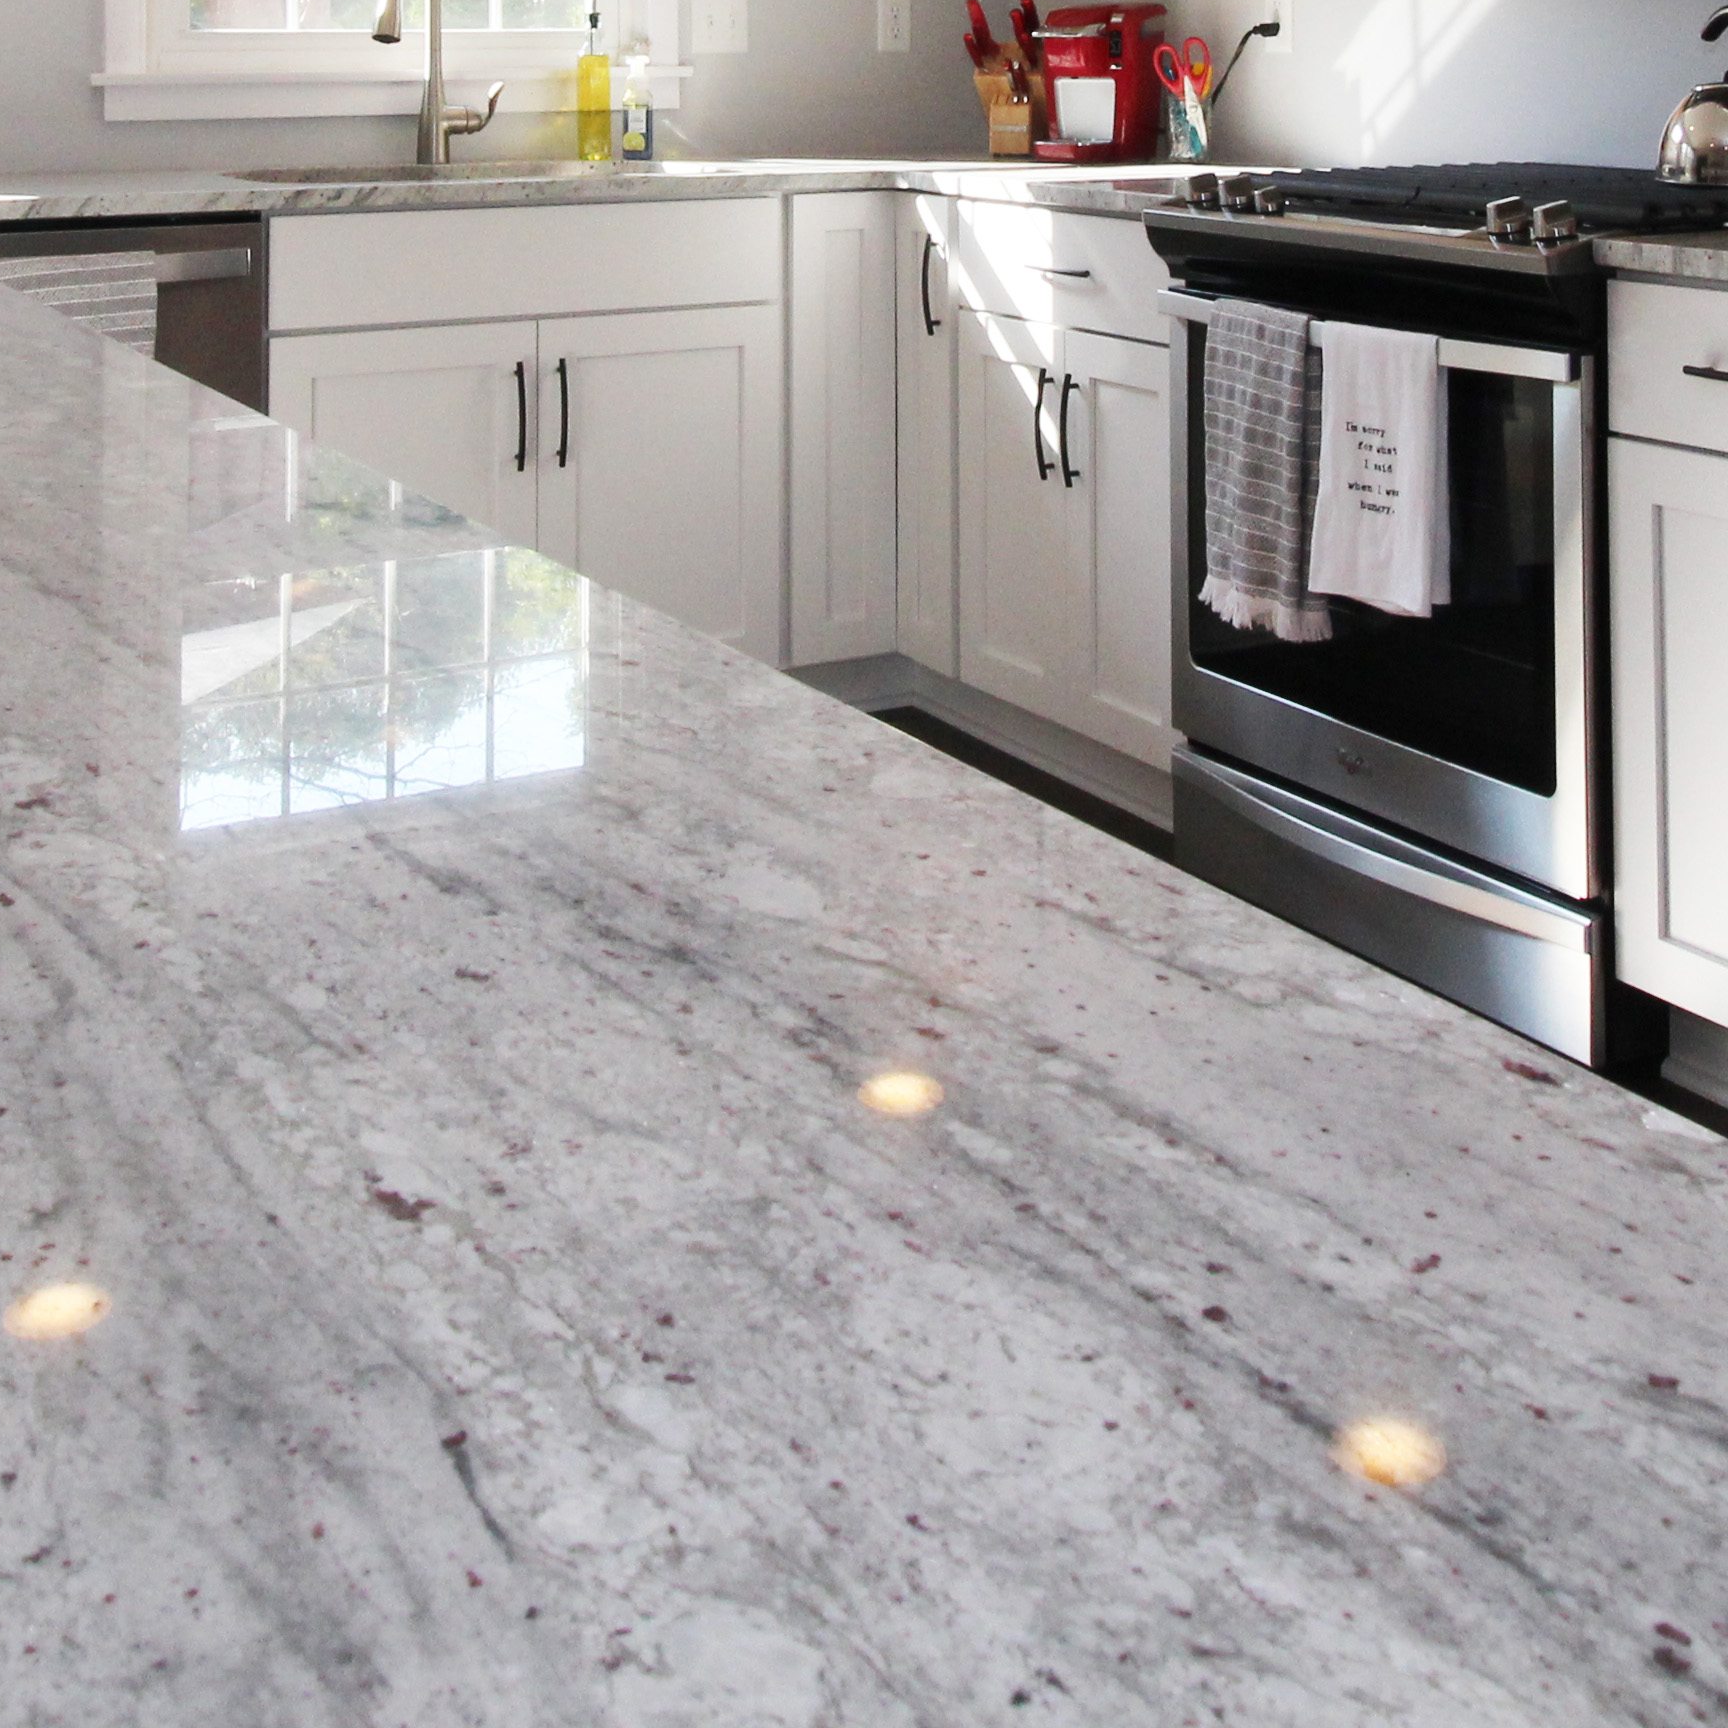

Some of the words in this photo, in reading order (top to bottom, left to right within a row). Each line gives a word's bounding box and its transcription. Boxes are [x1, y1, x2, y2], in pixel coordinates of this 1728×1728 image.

[1362, 426, 1385, 438] sorry
[1357, 440, 1373, 452] for
[1376, 446, 1398, 456] what
[1374, 462, 1393, 473] said
[1347, 481, 1373, 493] when
[1385, 488, 1400, 497] was
